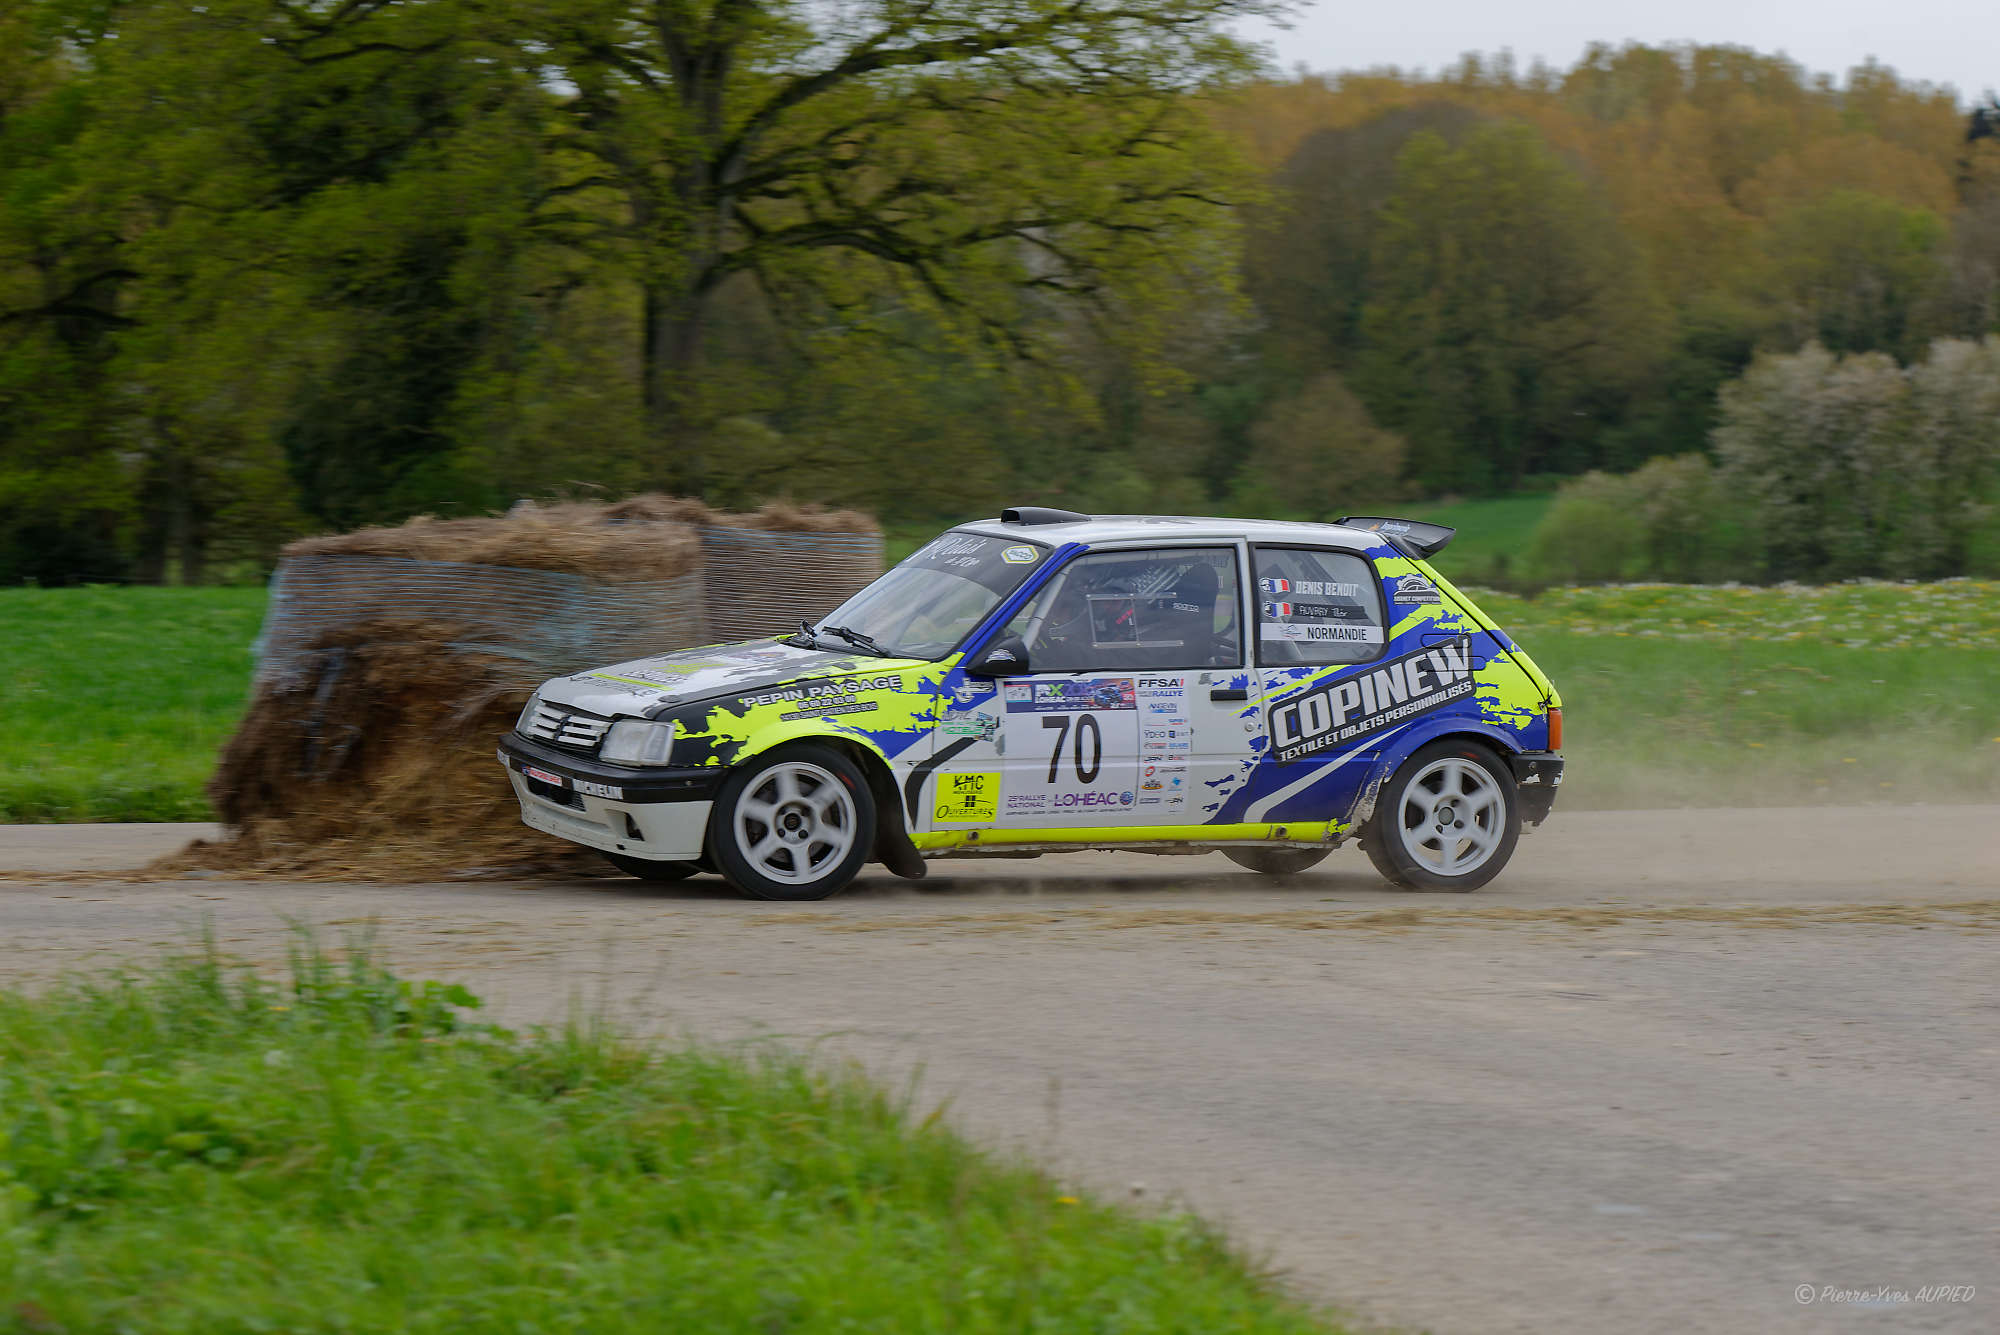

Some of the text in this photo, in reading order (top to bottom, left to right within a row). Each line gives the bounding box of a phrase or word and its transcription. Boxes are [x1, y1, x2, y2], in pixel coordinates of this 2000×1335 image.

[1296, 581, 1358, 596] DENIS BENOIT
[1307, 627, 1367, 640] NORMANDIE
[743, 675, 902, 708] PEPIN PAYSAGE
[1138, 679, 1179, 688] FFSA
[1273, 638, 1469, 748] COPINEW
[1280, 681, 1472, 762] TEXTILE ET OBJETS PERSONNALISÉS
[1042, 714, 1101, 784] 70
[954, 775, 984, 790] KMC
[1054, 790, 1118, 806] LOHÉAC
